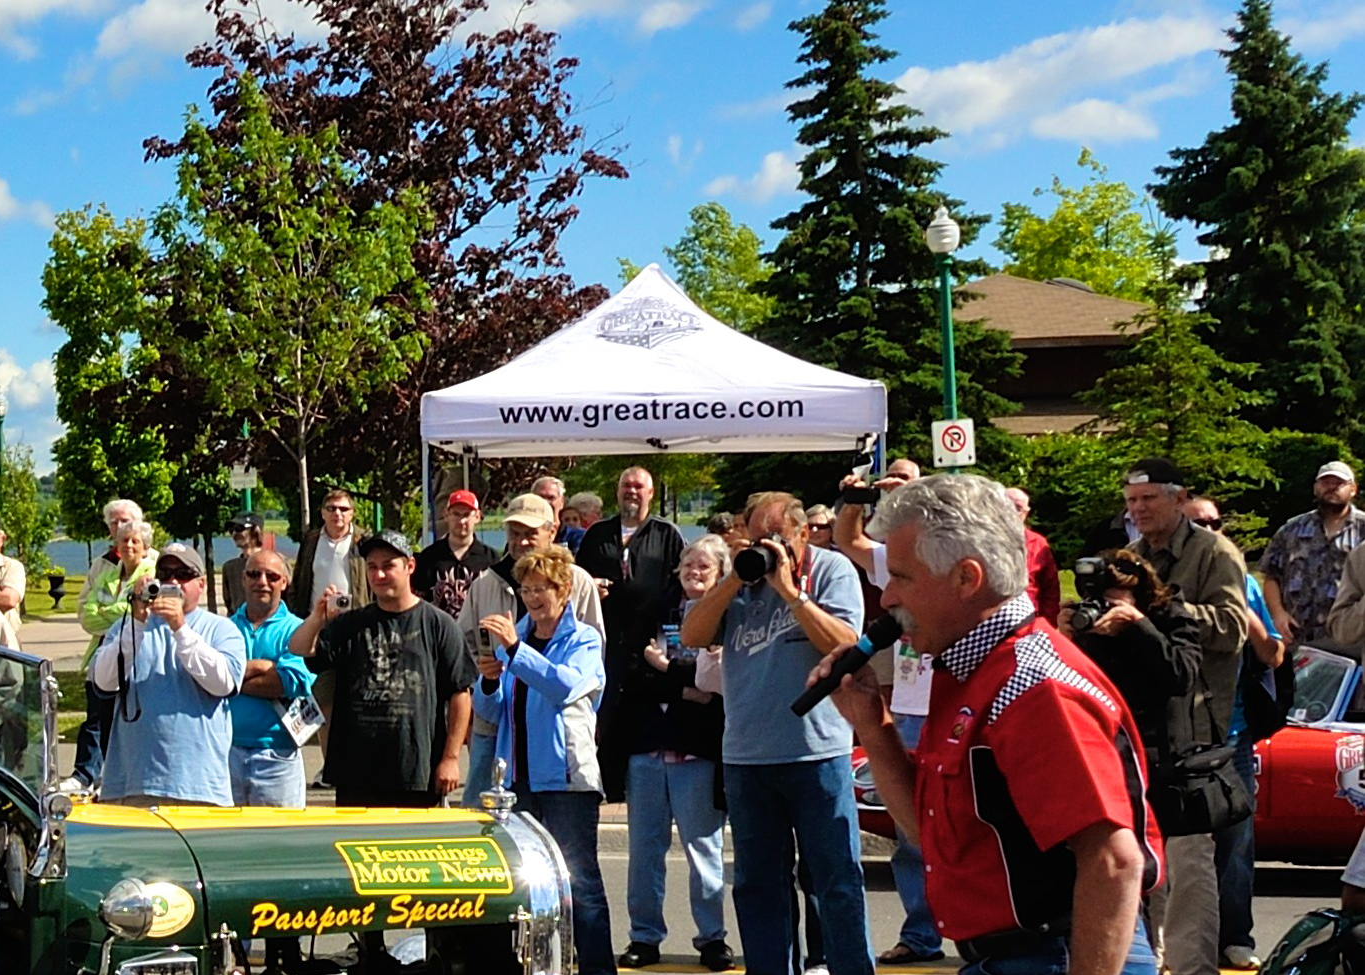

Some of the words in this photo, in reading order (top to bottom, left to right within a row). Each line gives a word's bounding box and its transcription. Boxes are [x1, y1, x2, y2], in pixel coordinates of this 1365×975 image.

[499, 399, 804, 428] www.greatrace.com
[355, 844, 488, 866] Hemmings
[355, 862, 431, 883] Motor
[442, 861, 505, 883] News
[251, 902, 376, 935] Passport
[386, 892, 486, 929] Special
